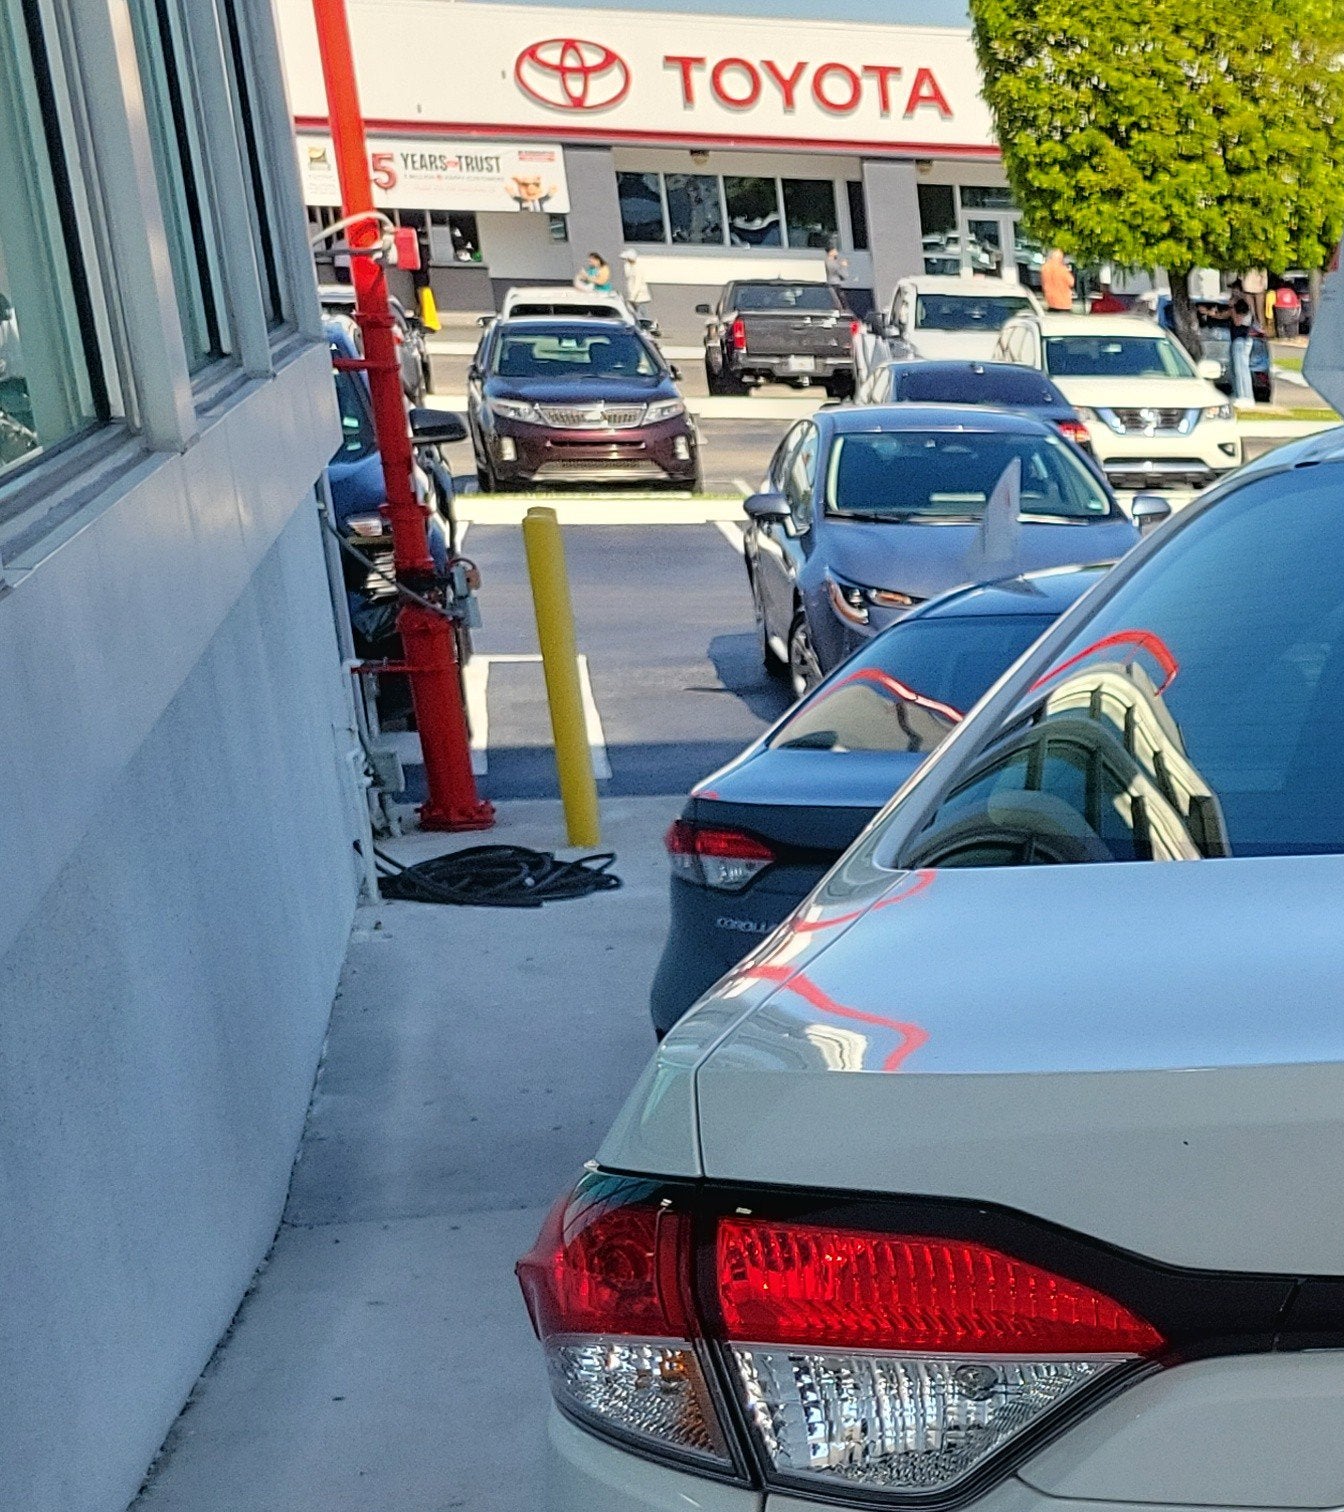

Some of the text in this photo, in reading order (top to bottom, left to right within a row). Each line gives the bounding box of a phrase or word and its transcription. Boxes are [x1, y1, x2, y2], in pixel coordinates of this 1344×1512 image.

[662, 55, 954, 119] TOYOTA
[400, 152, 448, 172] YEARS
[456, 155, 501, 174] TRUST
